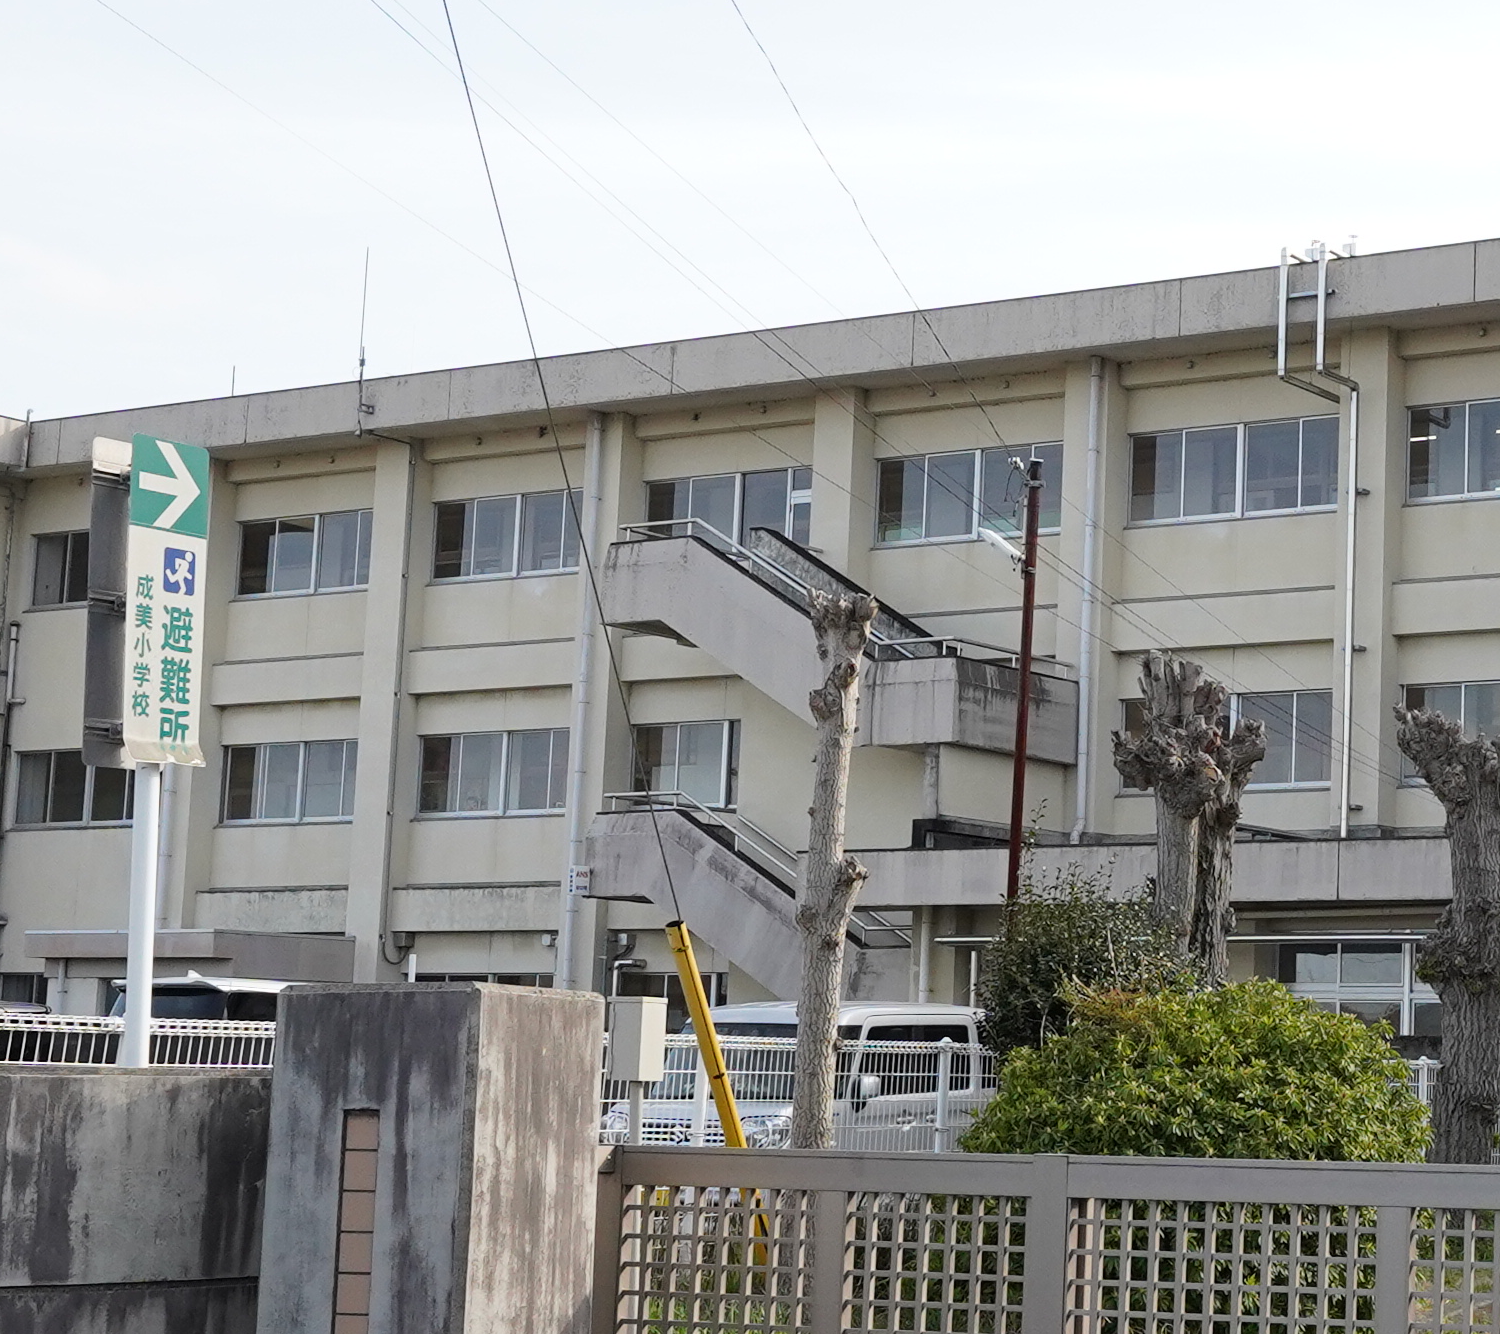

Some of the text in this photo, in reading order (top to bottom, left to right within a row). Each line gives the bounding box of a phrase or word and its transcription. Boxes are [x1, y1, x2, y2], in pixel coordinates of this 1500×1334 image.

[131, 574, 155, 718] 成美小学校
[159, 604, 194, 755] 避難所
